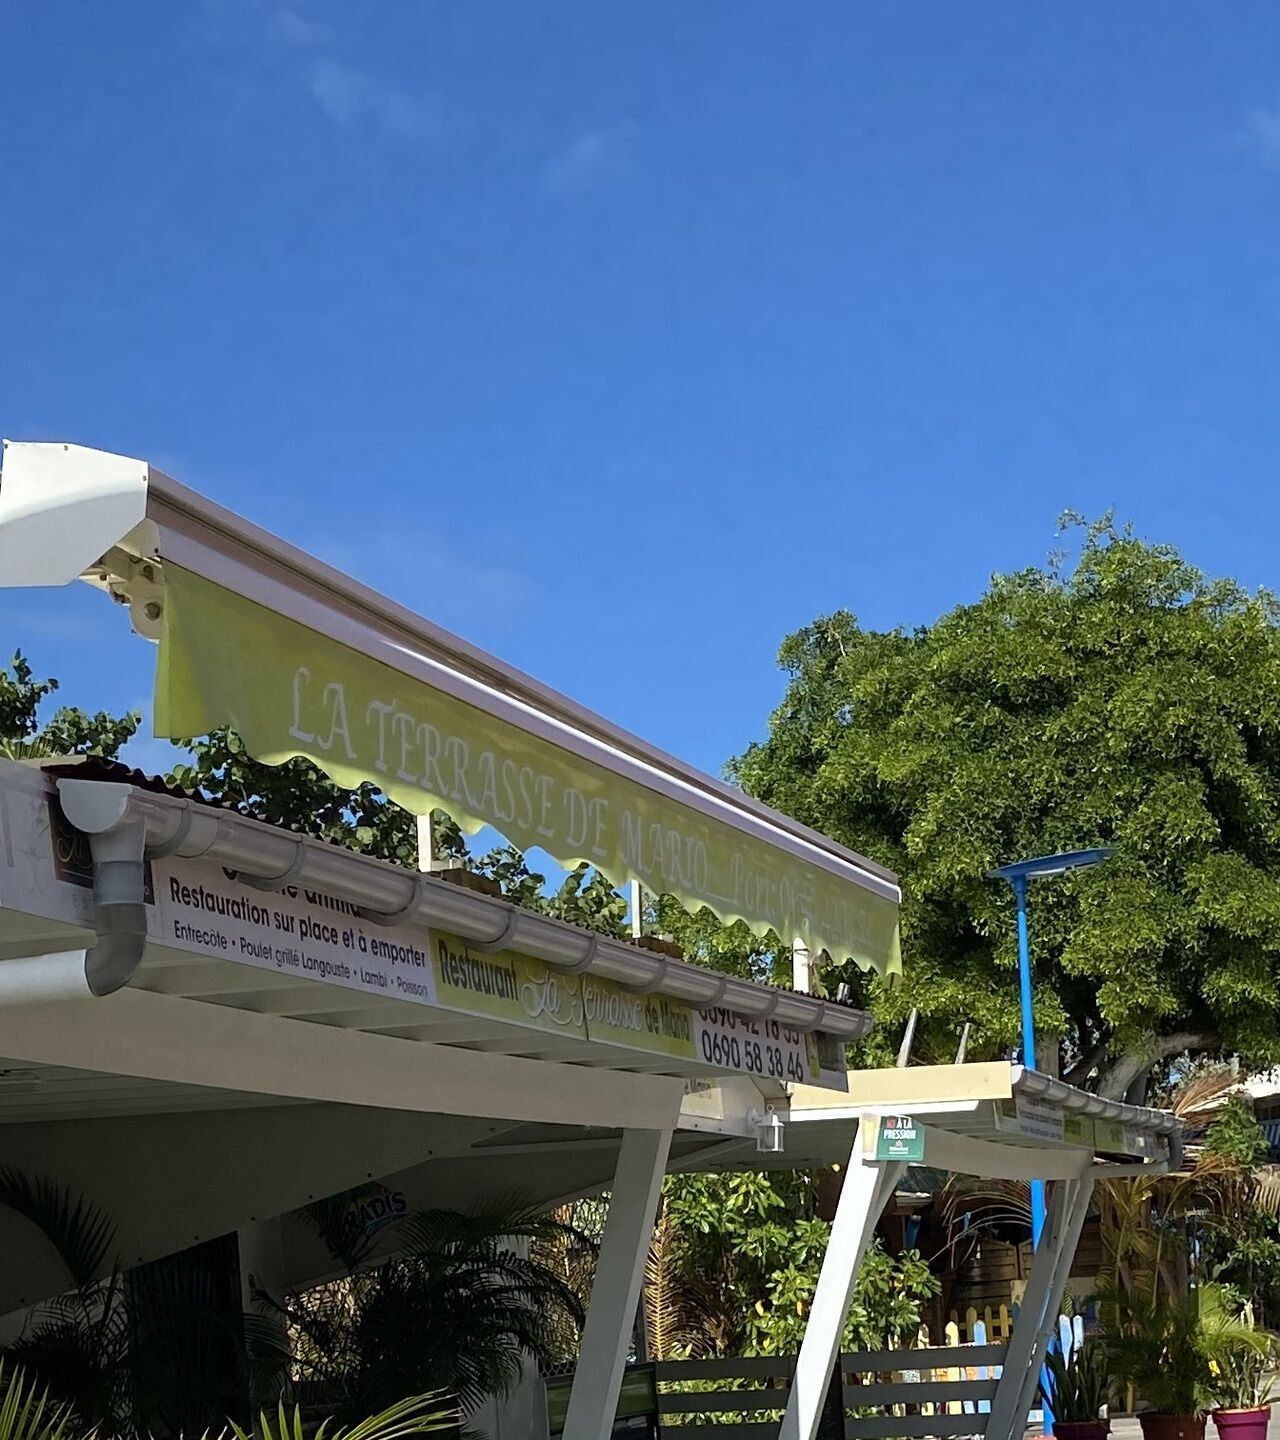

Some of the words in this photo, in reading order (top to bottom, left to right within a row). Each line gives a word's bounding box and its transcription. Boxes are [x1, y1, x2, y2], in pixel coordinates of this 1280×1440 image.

[288, 667, 357, 759] LA
[366, 700, 558, 838] TERRASSE
[563, 787, 608, 857] DE
[621, 810, 707, 894] MARIO
[170, 876, 270, 927] Restauration
[274, 911, 295, 933] sur
[300, 915, 338, 945] place
[342, 928, 355, 950] et
[359, 930, 368, 951] à
[371, 941, 426, 969] emporter
[174, 920, 228, 950] Entrecôte
[240, 936, 273, 961] Poulet
[274, 946, 300, 968] grillé
[302, 949, 350, 980] Langouste
[360, 966, 388, 989] Lambi
[397, 975, 428, 998] Poisson
[437, 938, 519, 1001] Restaurant
[644, 996, 660, 1035] de
[661, 1000, 690, 1042] Mario
[702, 1029, 741, 1069] 0690
[744, 1040, 762, 1073] 58
[766, 1045, 783, 1078] 38
[787, 1051, 803, 1082] 46
[883, 1129, 917, 1140] PRESSION
